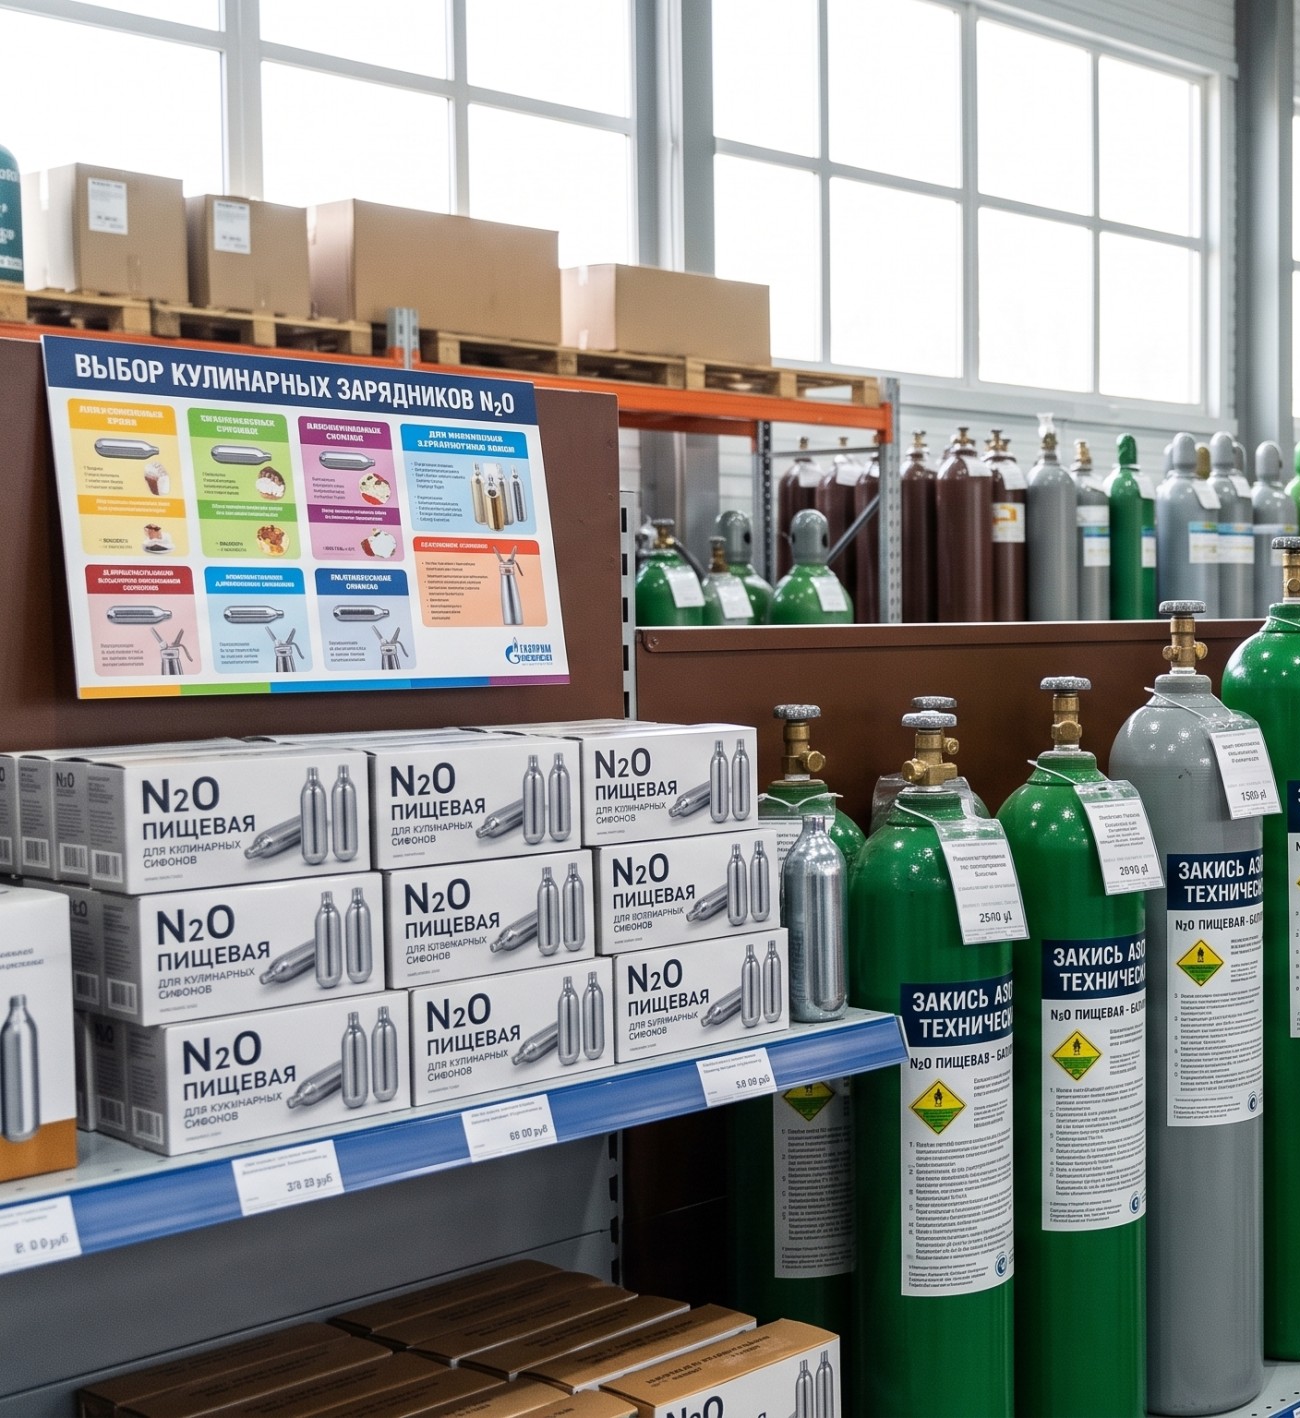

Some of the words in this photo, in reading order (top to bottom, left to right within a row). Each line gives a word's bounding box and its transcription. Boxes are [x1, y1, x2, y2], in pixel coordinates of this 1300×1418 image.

[74, 353, 164, 384] ВЫБОР
[171, 362, 333, 399] КУЛИНАРНЫХ
[336, 377, 475, 410] ЗАРЯДНИКОВ
[479, 390, 515, 417] N2O
[390, 762, 456, 798] N2O
[594, 747, 651, 780] N2O
[142, 775, 220, 815] N2O
[595, 780, 678, 801] ПИЩЕВАЯ
[391, 798, 486, 821] ПИЩЕВАЯ
[143, 815, 256, 840] ПИЩЕВАЯ
[612, 852, 669, 888] N2O
[1179, 859, 1244, 879] ЗАКИСЬ
[404, 877, 471, 916] N2O
[613, 884, 696, 910] ПИЩЕВАЯ
[157, 904, 235, 946] N2O
[406, 911, 500, 940] ПИЩЕВАЯ
[158, 941, 271, 972] ПИЩЕВАЯ
[1053, 946, 1123, 966] ЗАКИСЬ
[627, 958, 683, 995] N2O
[426, 992, 491, 1033] N2O
[628, 988, 710, 1018] ПИЩЕВАЯ
[913, 989, 988, 1011] ЗАКИСЬ
[183, 1030, 262, 1075] N2O
[427, 1024, 521, 1057] ПИЩЕВАЯ
[910, 1058, 931, 1070] N2O
[184, 1065, 296, 1101] ПИЩЕВАЯ
